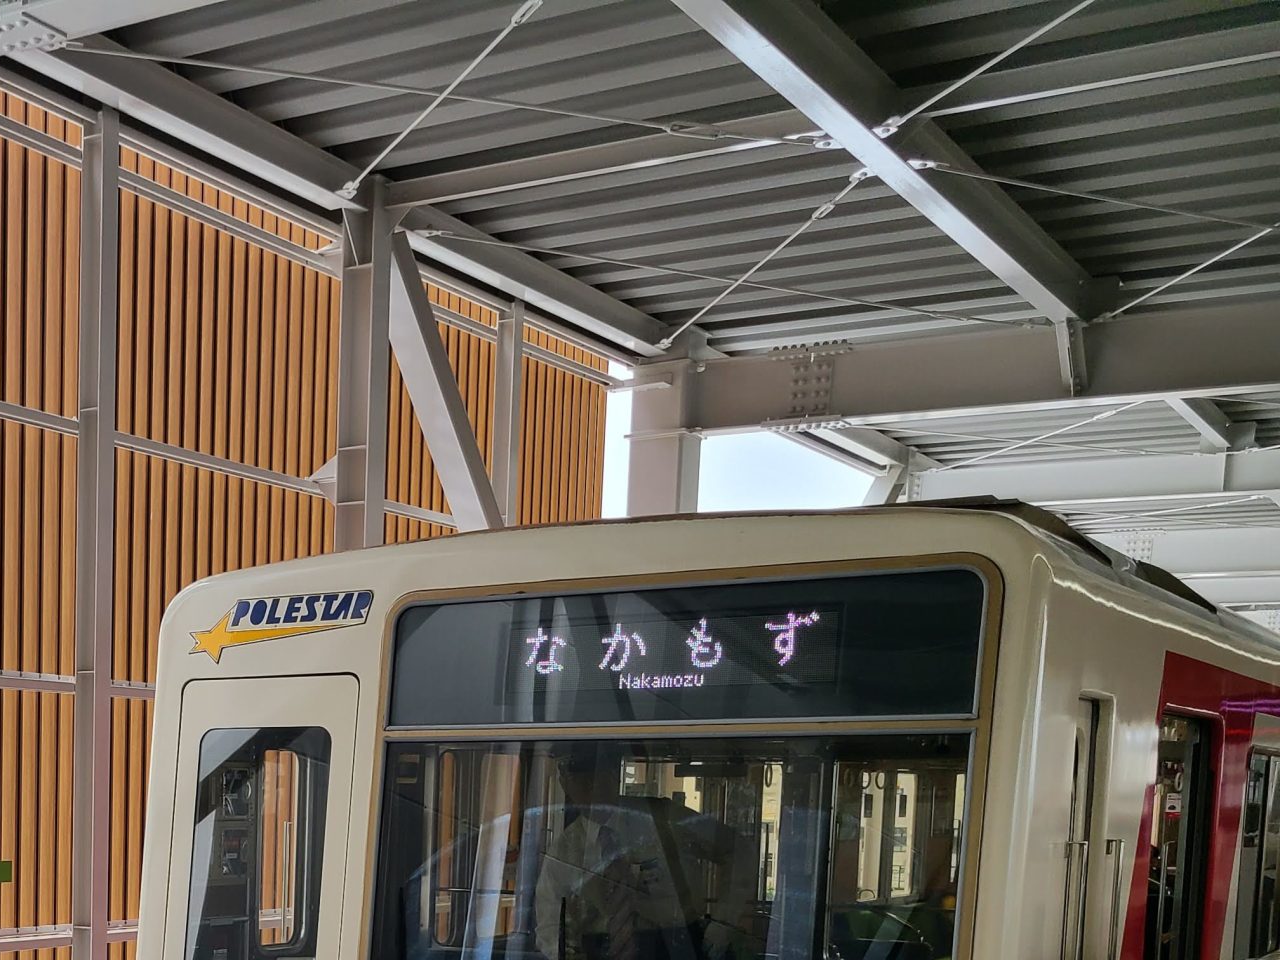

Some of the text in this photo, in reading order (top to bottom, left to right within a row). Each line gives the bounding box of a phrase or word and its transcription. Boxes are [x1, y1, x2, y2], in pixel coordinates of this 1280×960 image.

[231, 592, 371, 627] POLESTAR
[526, 610, 819, 674] なかもず
[619, 673, 704, 689] Nakamozu
